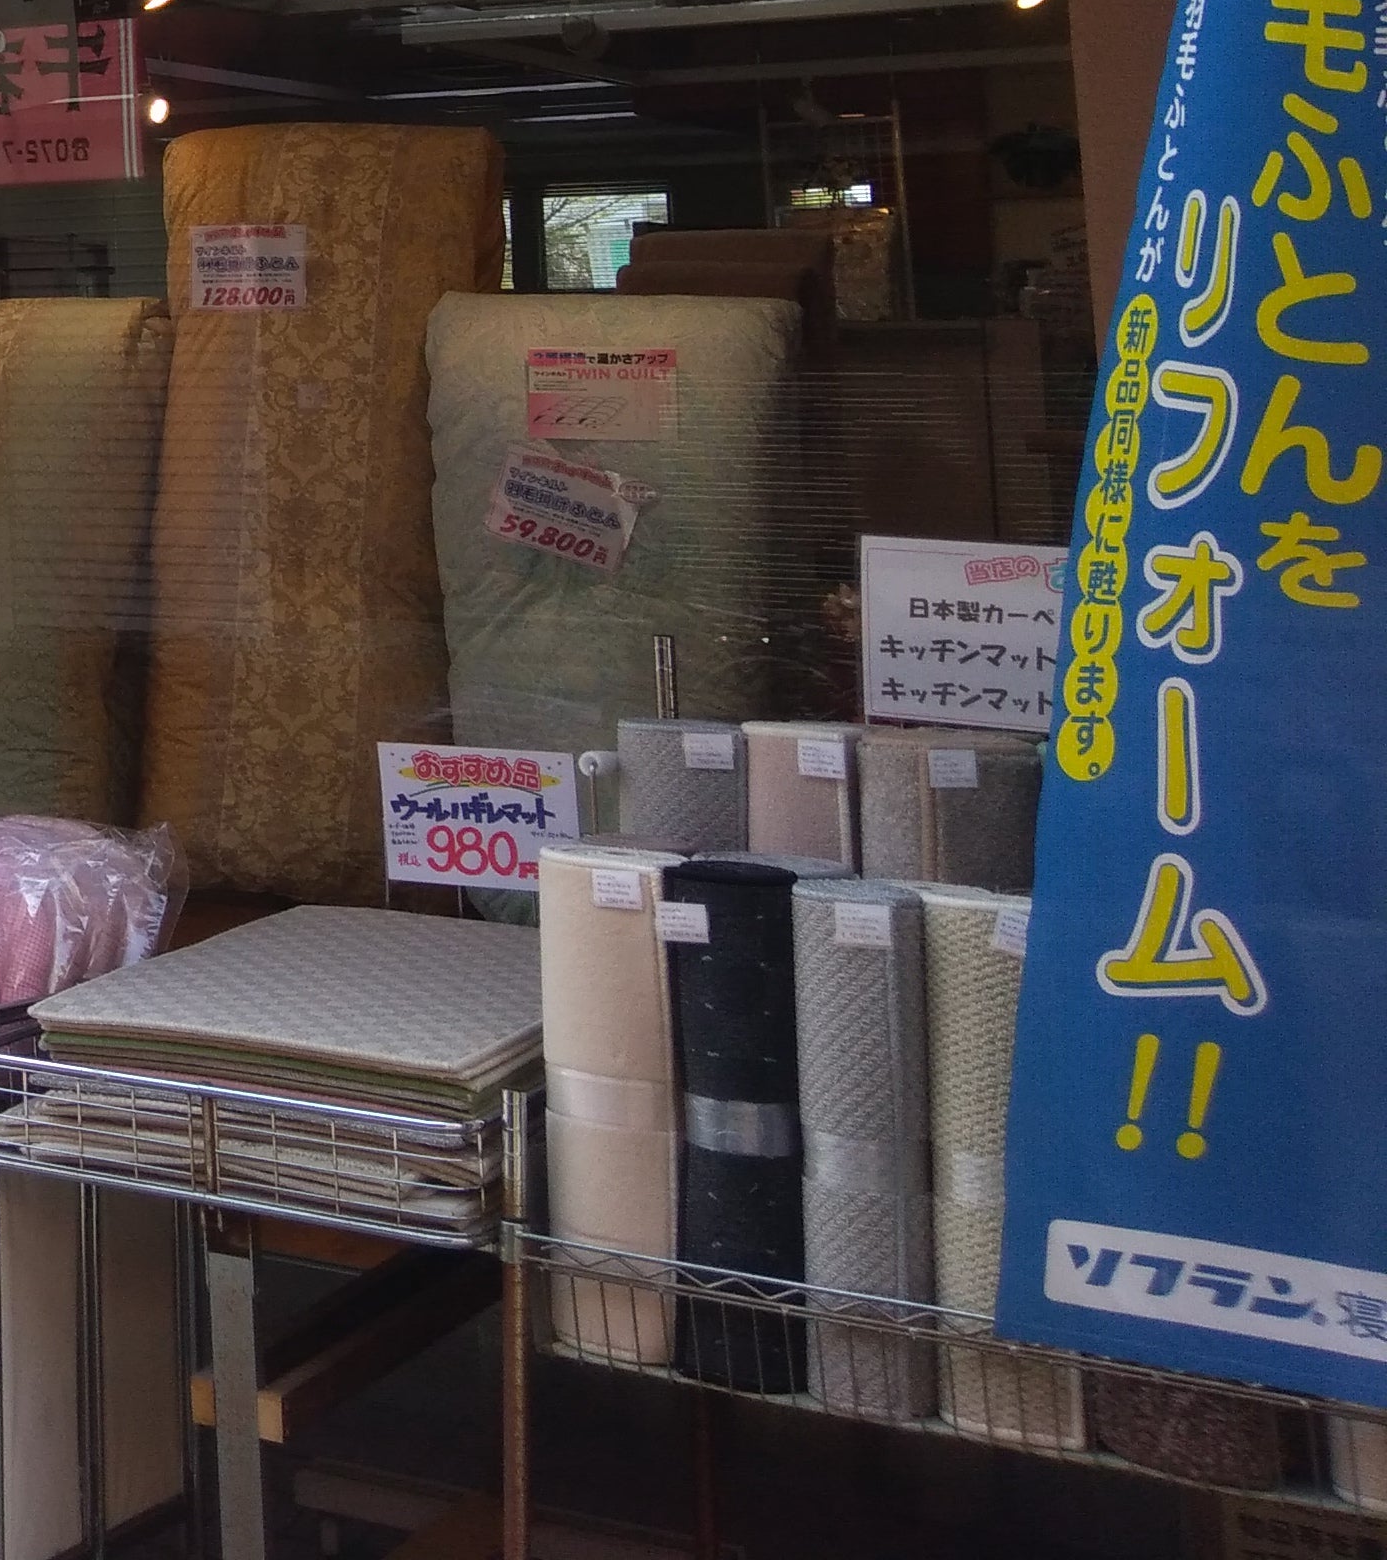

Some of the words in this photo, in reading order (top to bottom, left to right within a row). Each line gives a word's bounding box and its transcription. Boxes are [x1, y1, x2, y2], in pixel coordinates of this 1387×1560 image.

[567, 367, 611, 381] TWIN
[616, 367, 671, 381] QUILT
[909, 597, 1055, 626] 日本製カーペ
[879, 634, 1057, 672] キッチンマット
[881, 677, 1054, 716] キッチンマット
[412, 750, 542, 791] おすすめ品
[390, 792, 556, 830] ウールハギレマット
[397, 851, 422, 867] 税込
[1066, 1243, 1315, 1320] ソフラン
